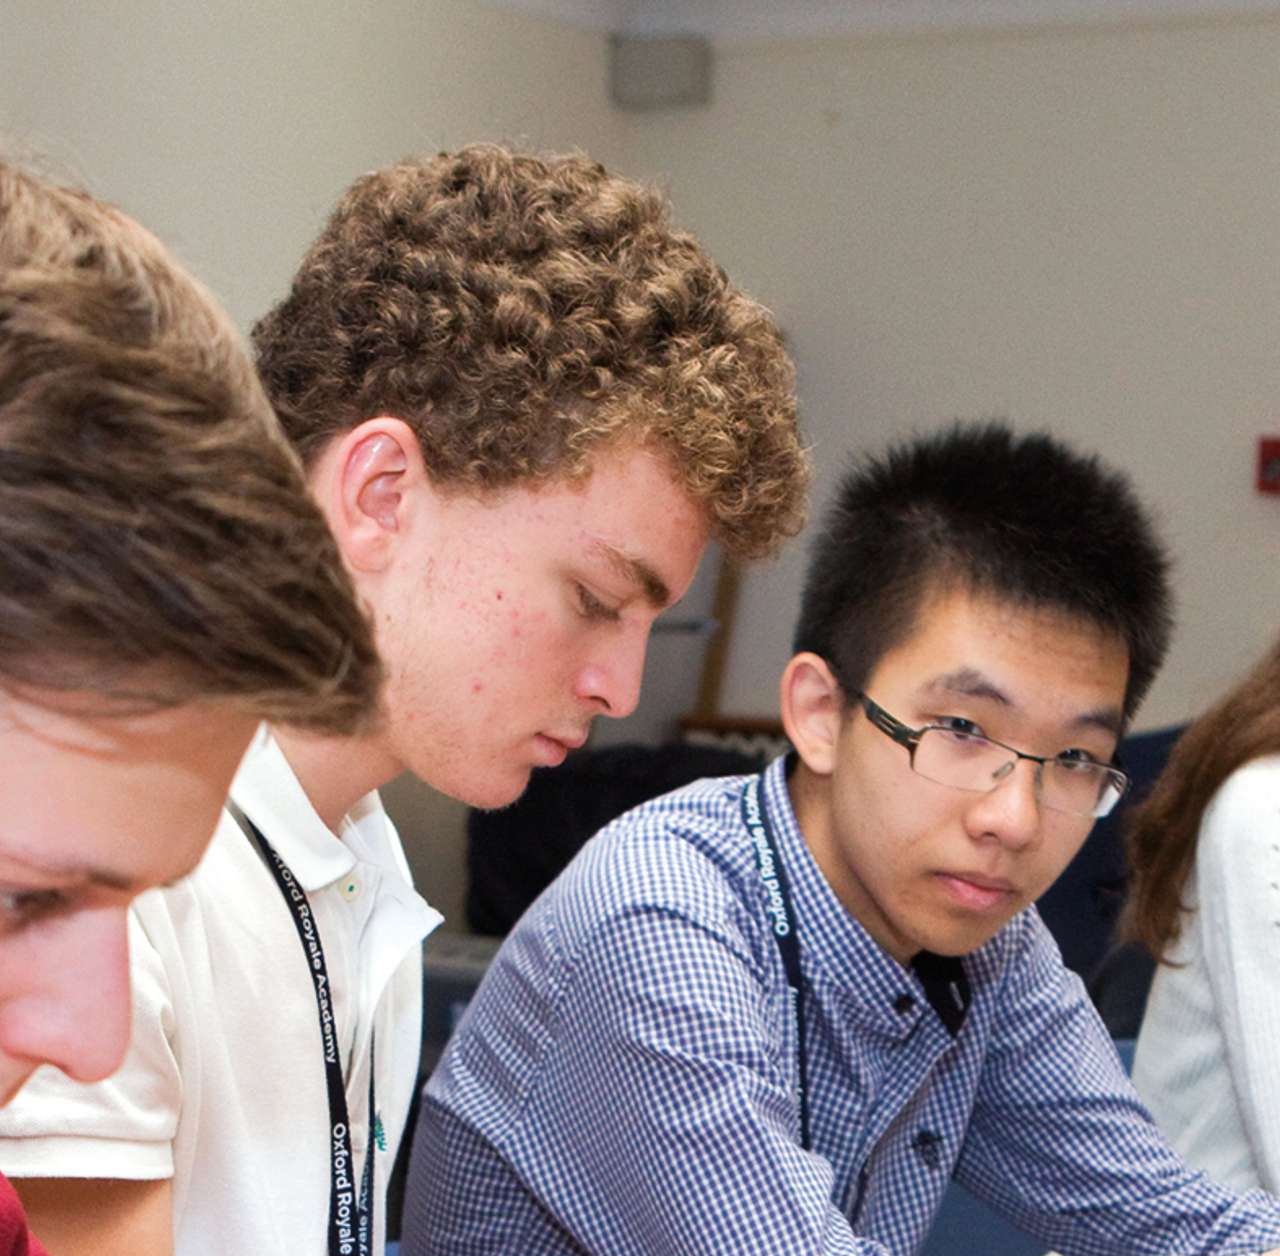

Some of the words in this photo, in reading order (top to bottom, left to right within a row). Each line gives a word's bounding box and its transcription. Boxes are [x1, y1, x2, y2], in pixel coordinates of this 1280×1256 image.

[767, 878, 790, 936] Oxford
[298, 904, 322, 970] Royale
[316, 973, 337, 1064] Academy
[332, 1123, 351, 1189] Oxford
[335, 1191, 353, 1254] Royale
